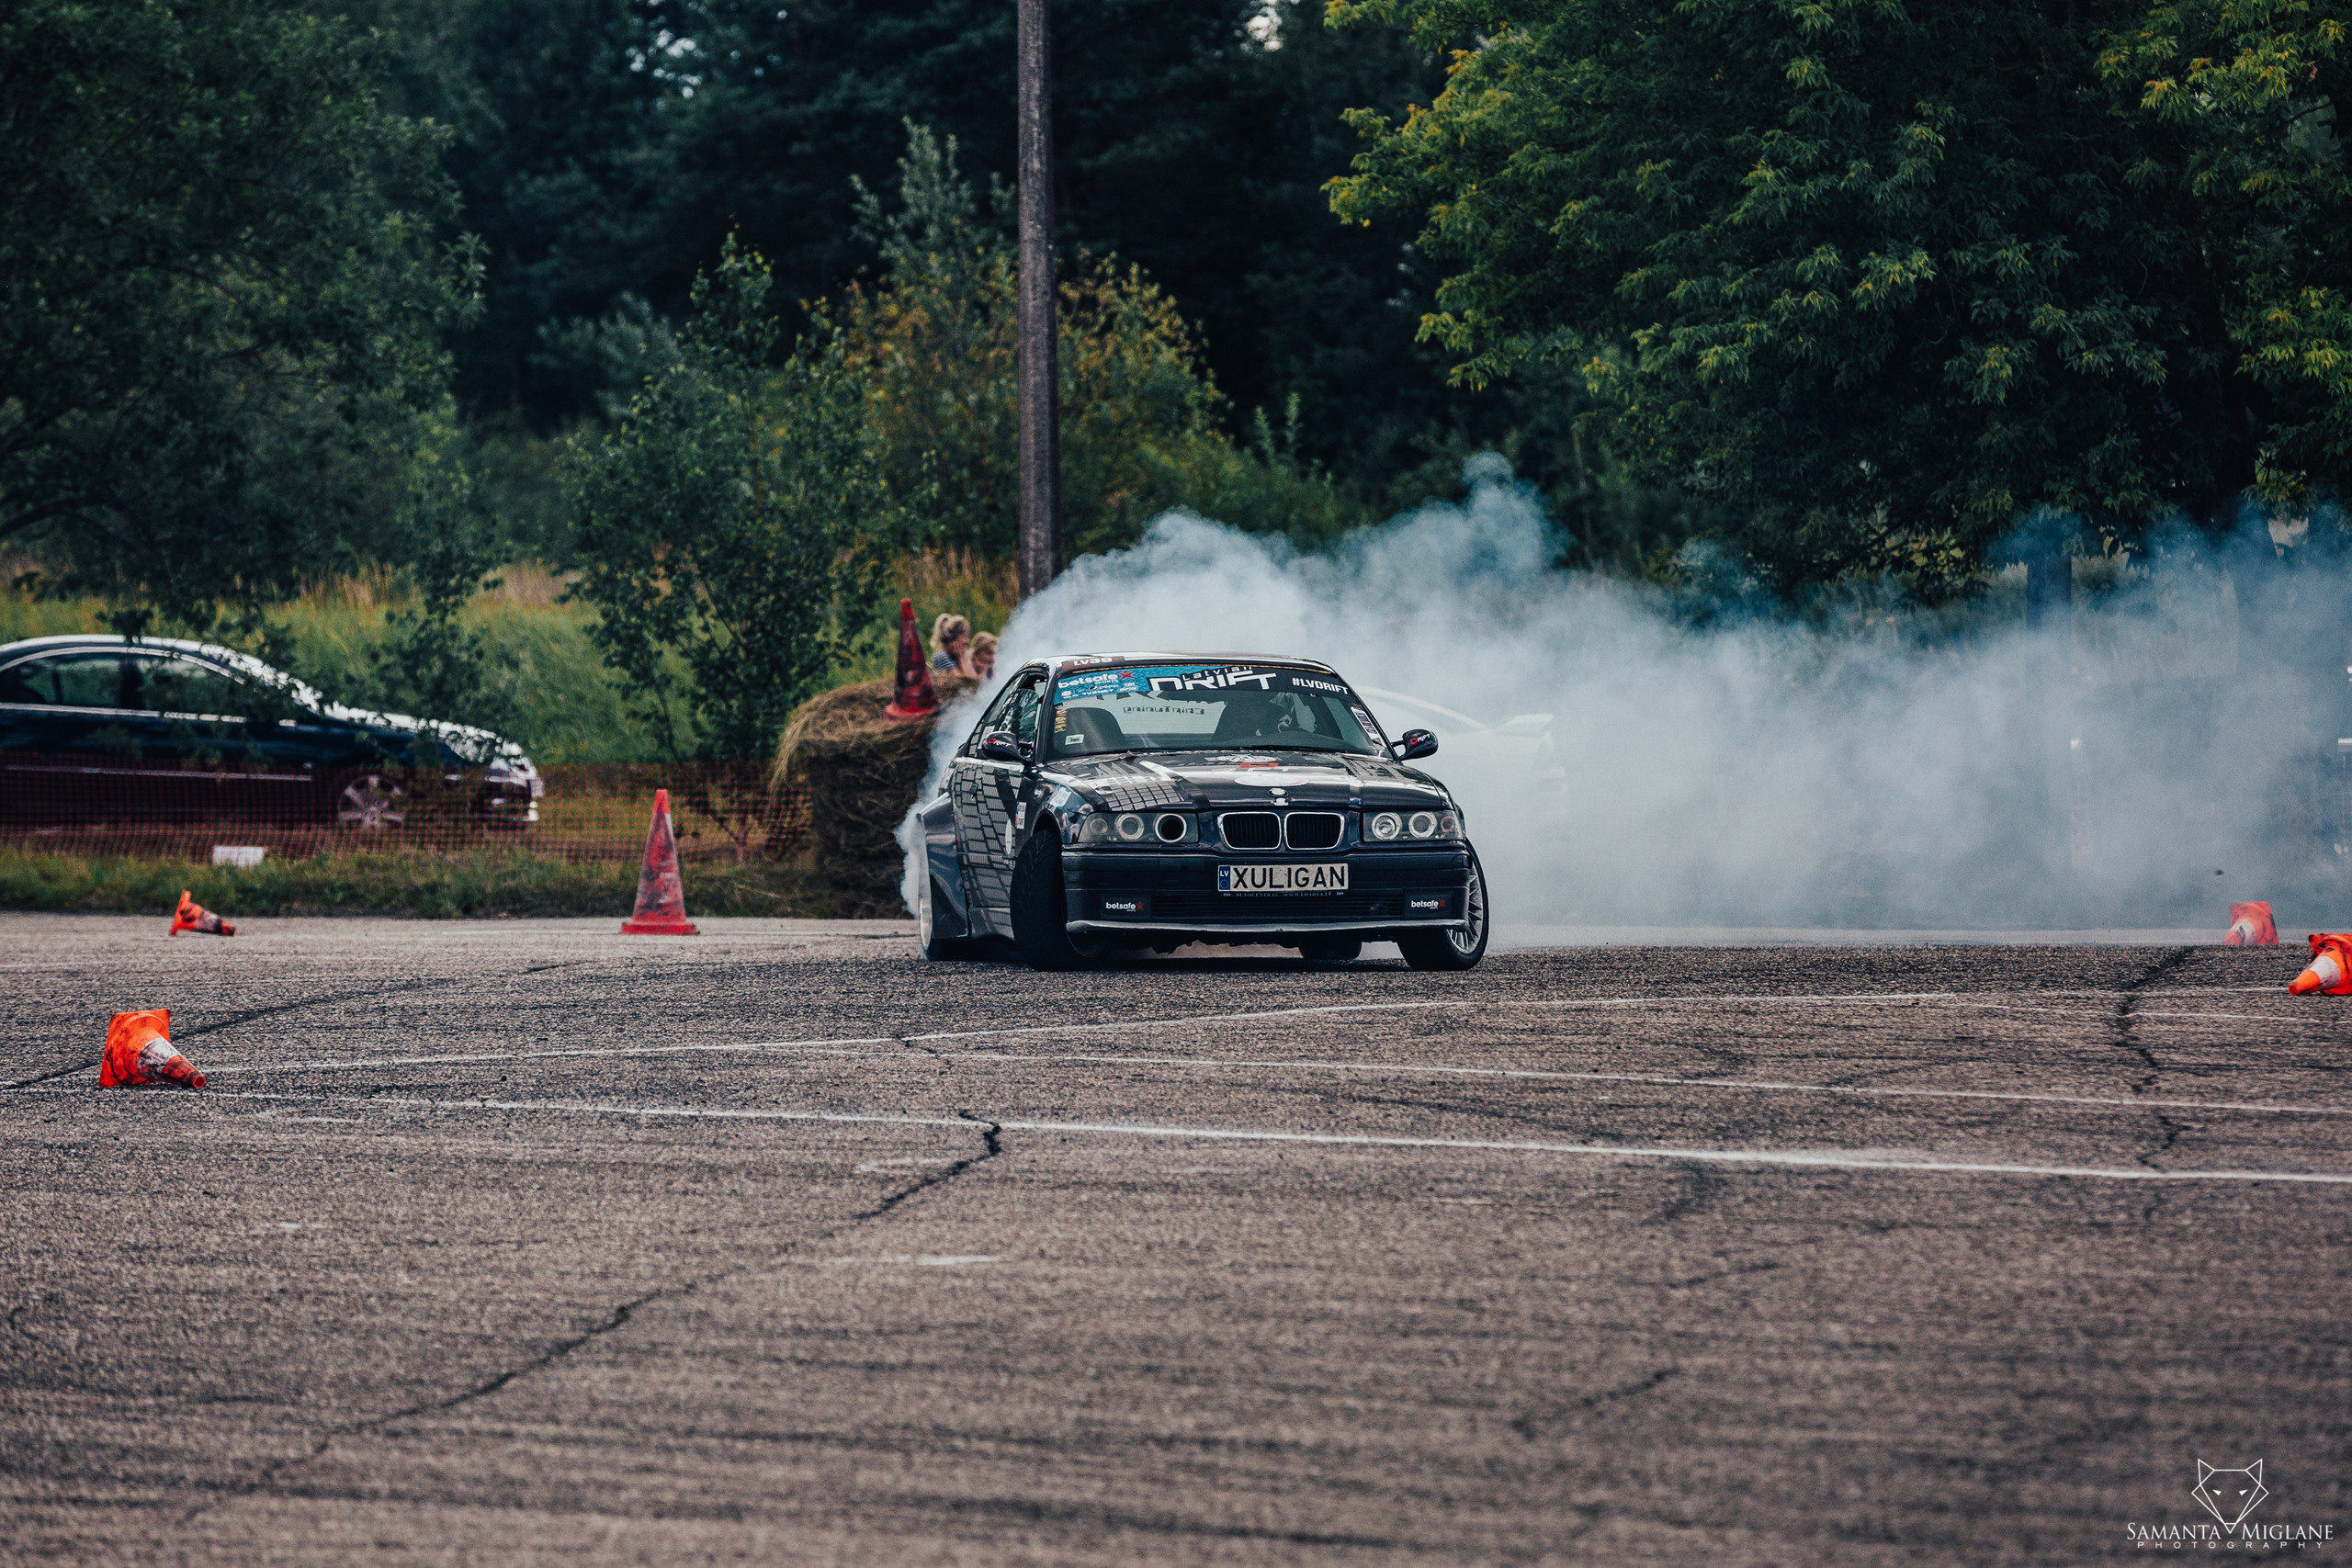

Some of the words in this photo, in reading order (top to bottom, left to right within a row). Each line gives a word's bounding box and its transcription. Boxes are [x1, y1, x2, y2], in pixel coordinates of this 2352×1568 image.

[1057, 673, 1118, 689] betsafe
[1291, 677, 1349, 694] #LVDRIFT
[1233, 865, 1345, 889] XULIGAN
